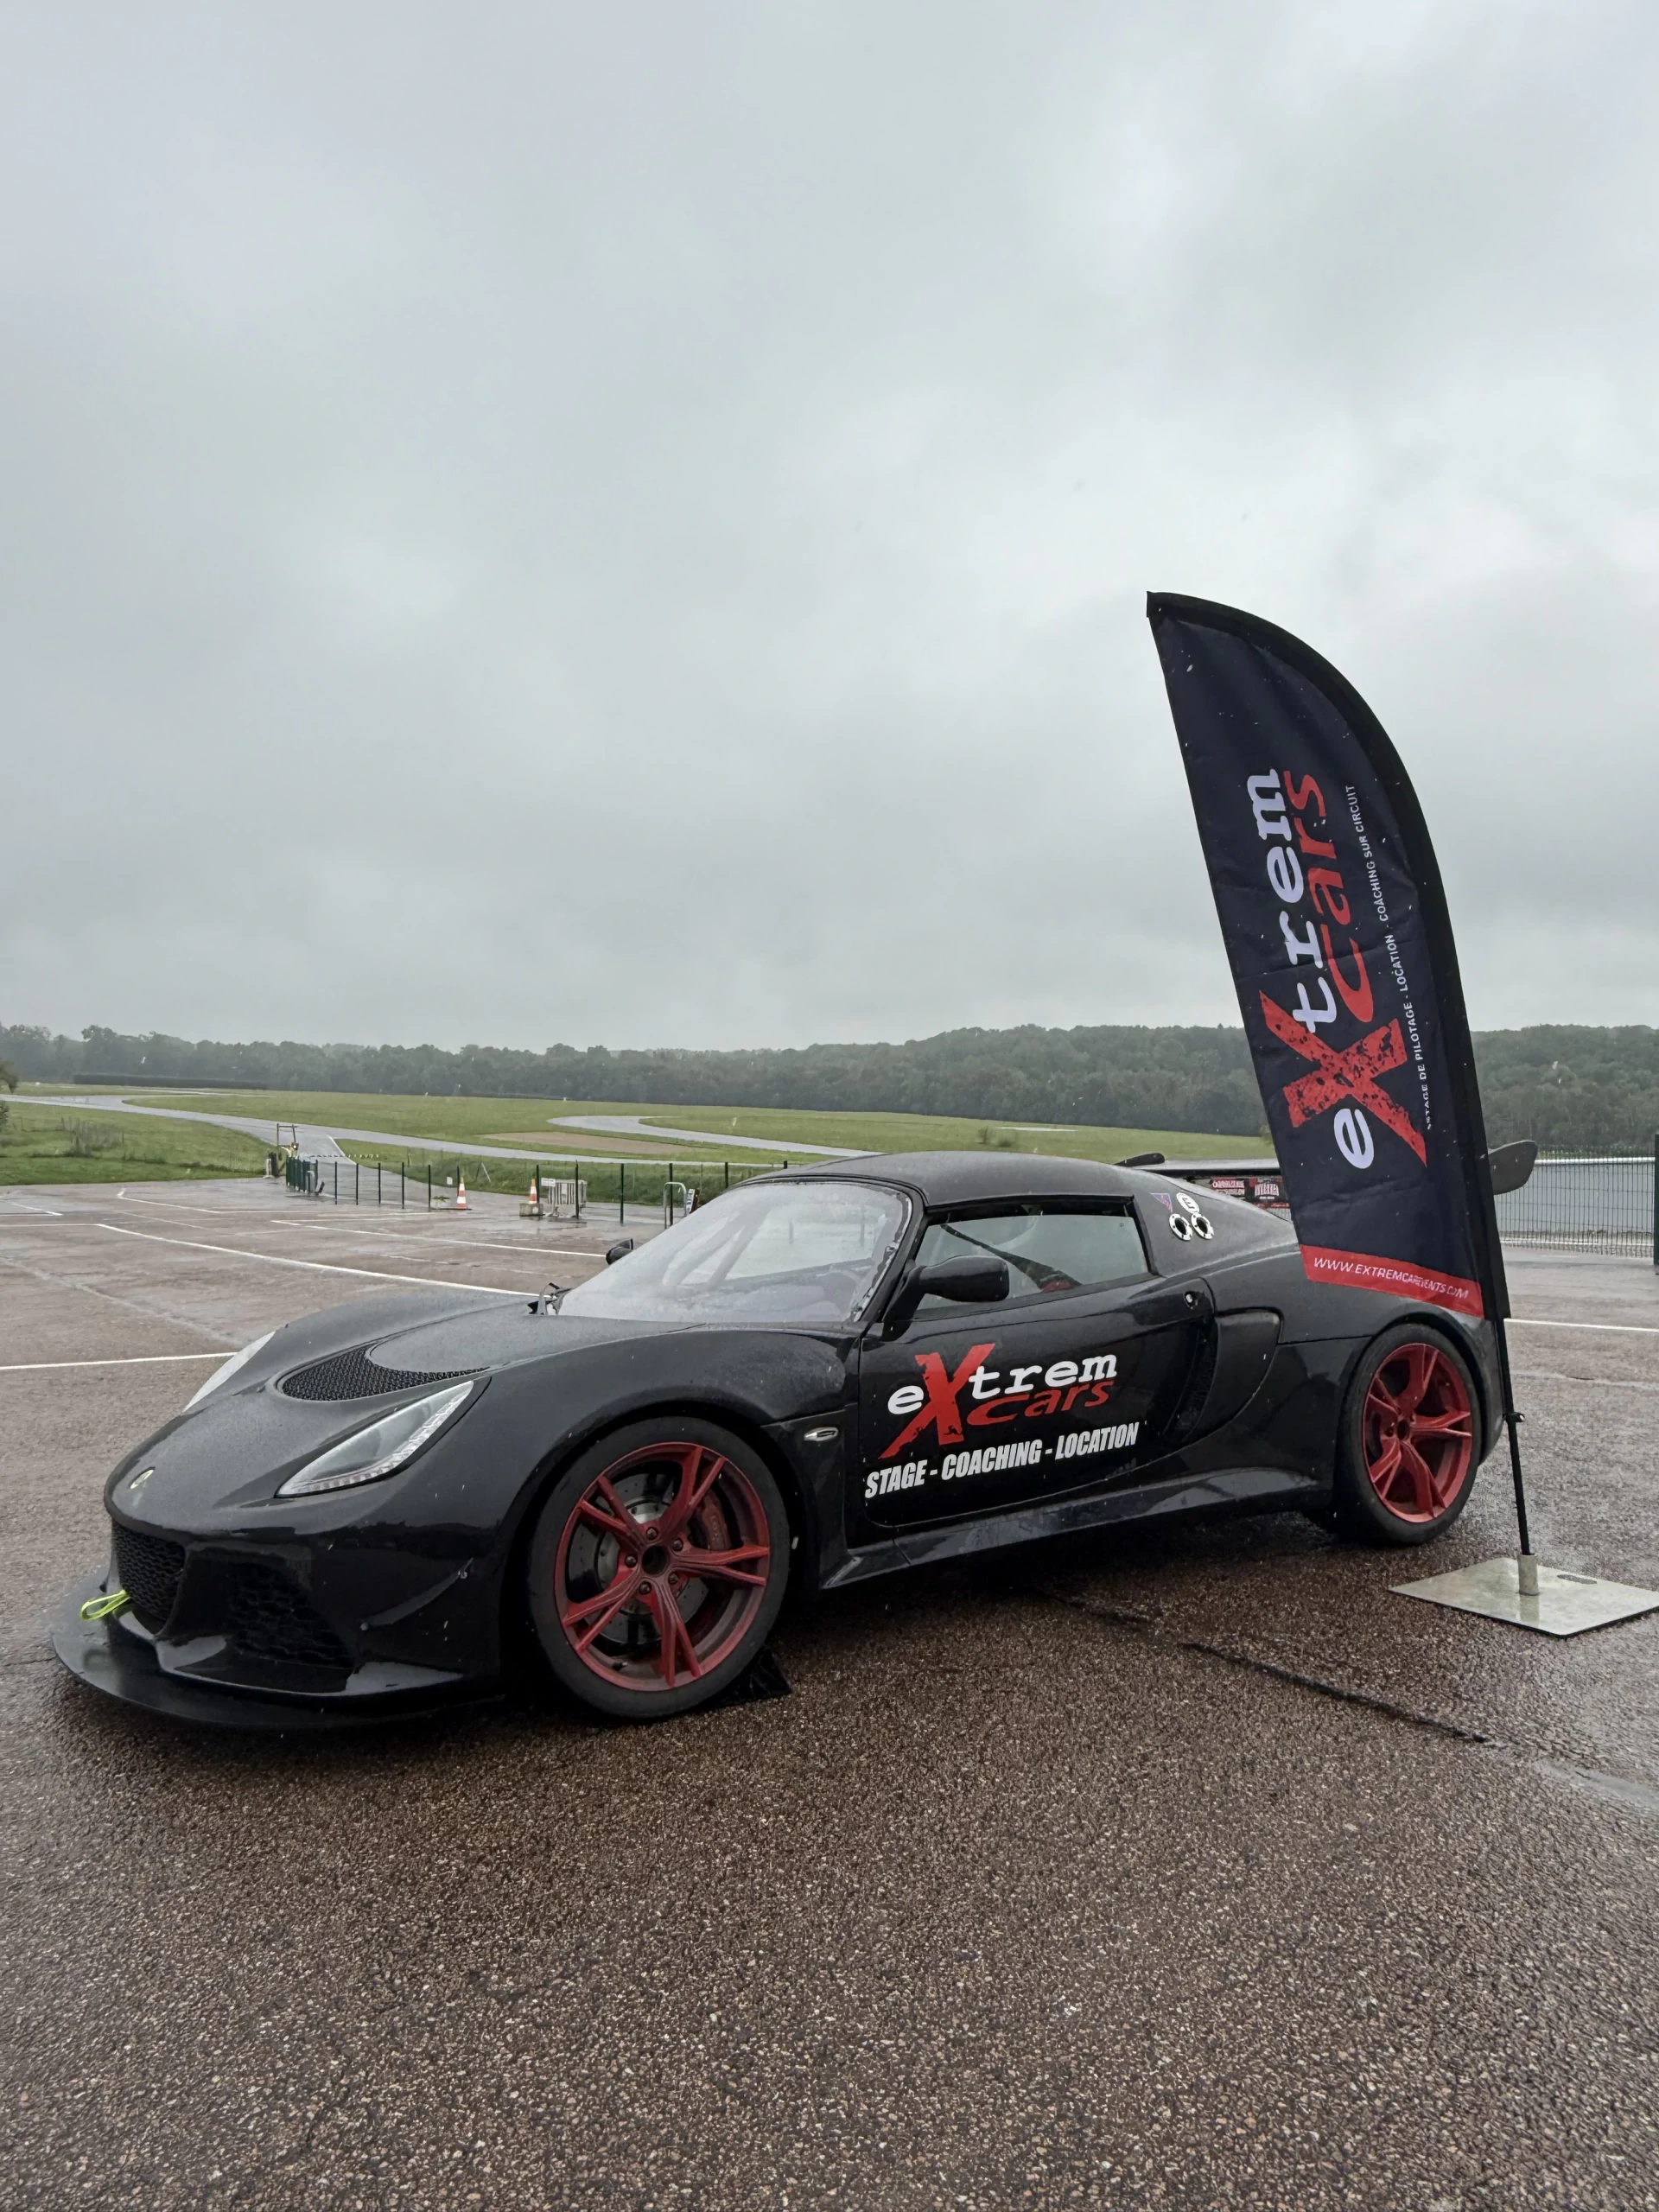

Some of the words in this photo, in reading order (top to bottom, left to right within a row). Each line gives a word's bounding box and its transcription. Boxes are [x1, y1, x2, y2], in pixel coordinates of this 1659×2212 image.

[1345, 785, 1364, 832] CIRCUIT
[1358, 836, 1373, 858] SUR
[1366, 861, 1389, 922] COACHING
[1247, 768, 1427, 1169] eXtrem
[1384, 934, 1408, 992] LOCATION
[1403, 1001, 1423, 1061] PILOTAGE
[1417, 1064, 1427, 1080] DE
[878, 1343, 1117, 1459] eXtrem
[864, 1461, 927, 1499] STAGE
[941, 1439, 1043, 1480] COACHING
[1055, 1422, 1140, 1459] LOCATION
